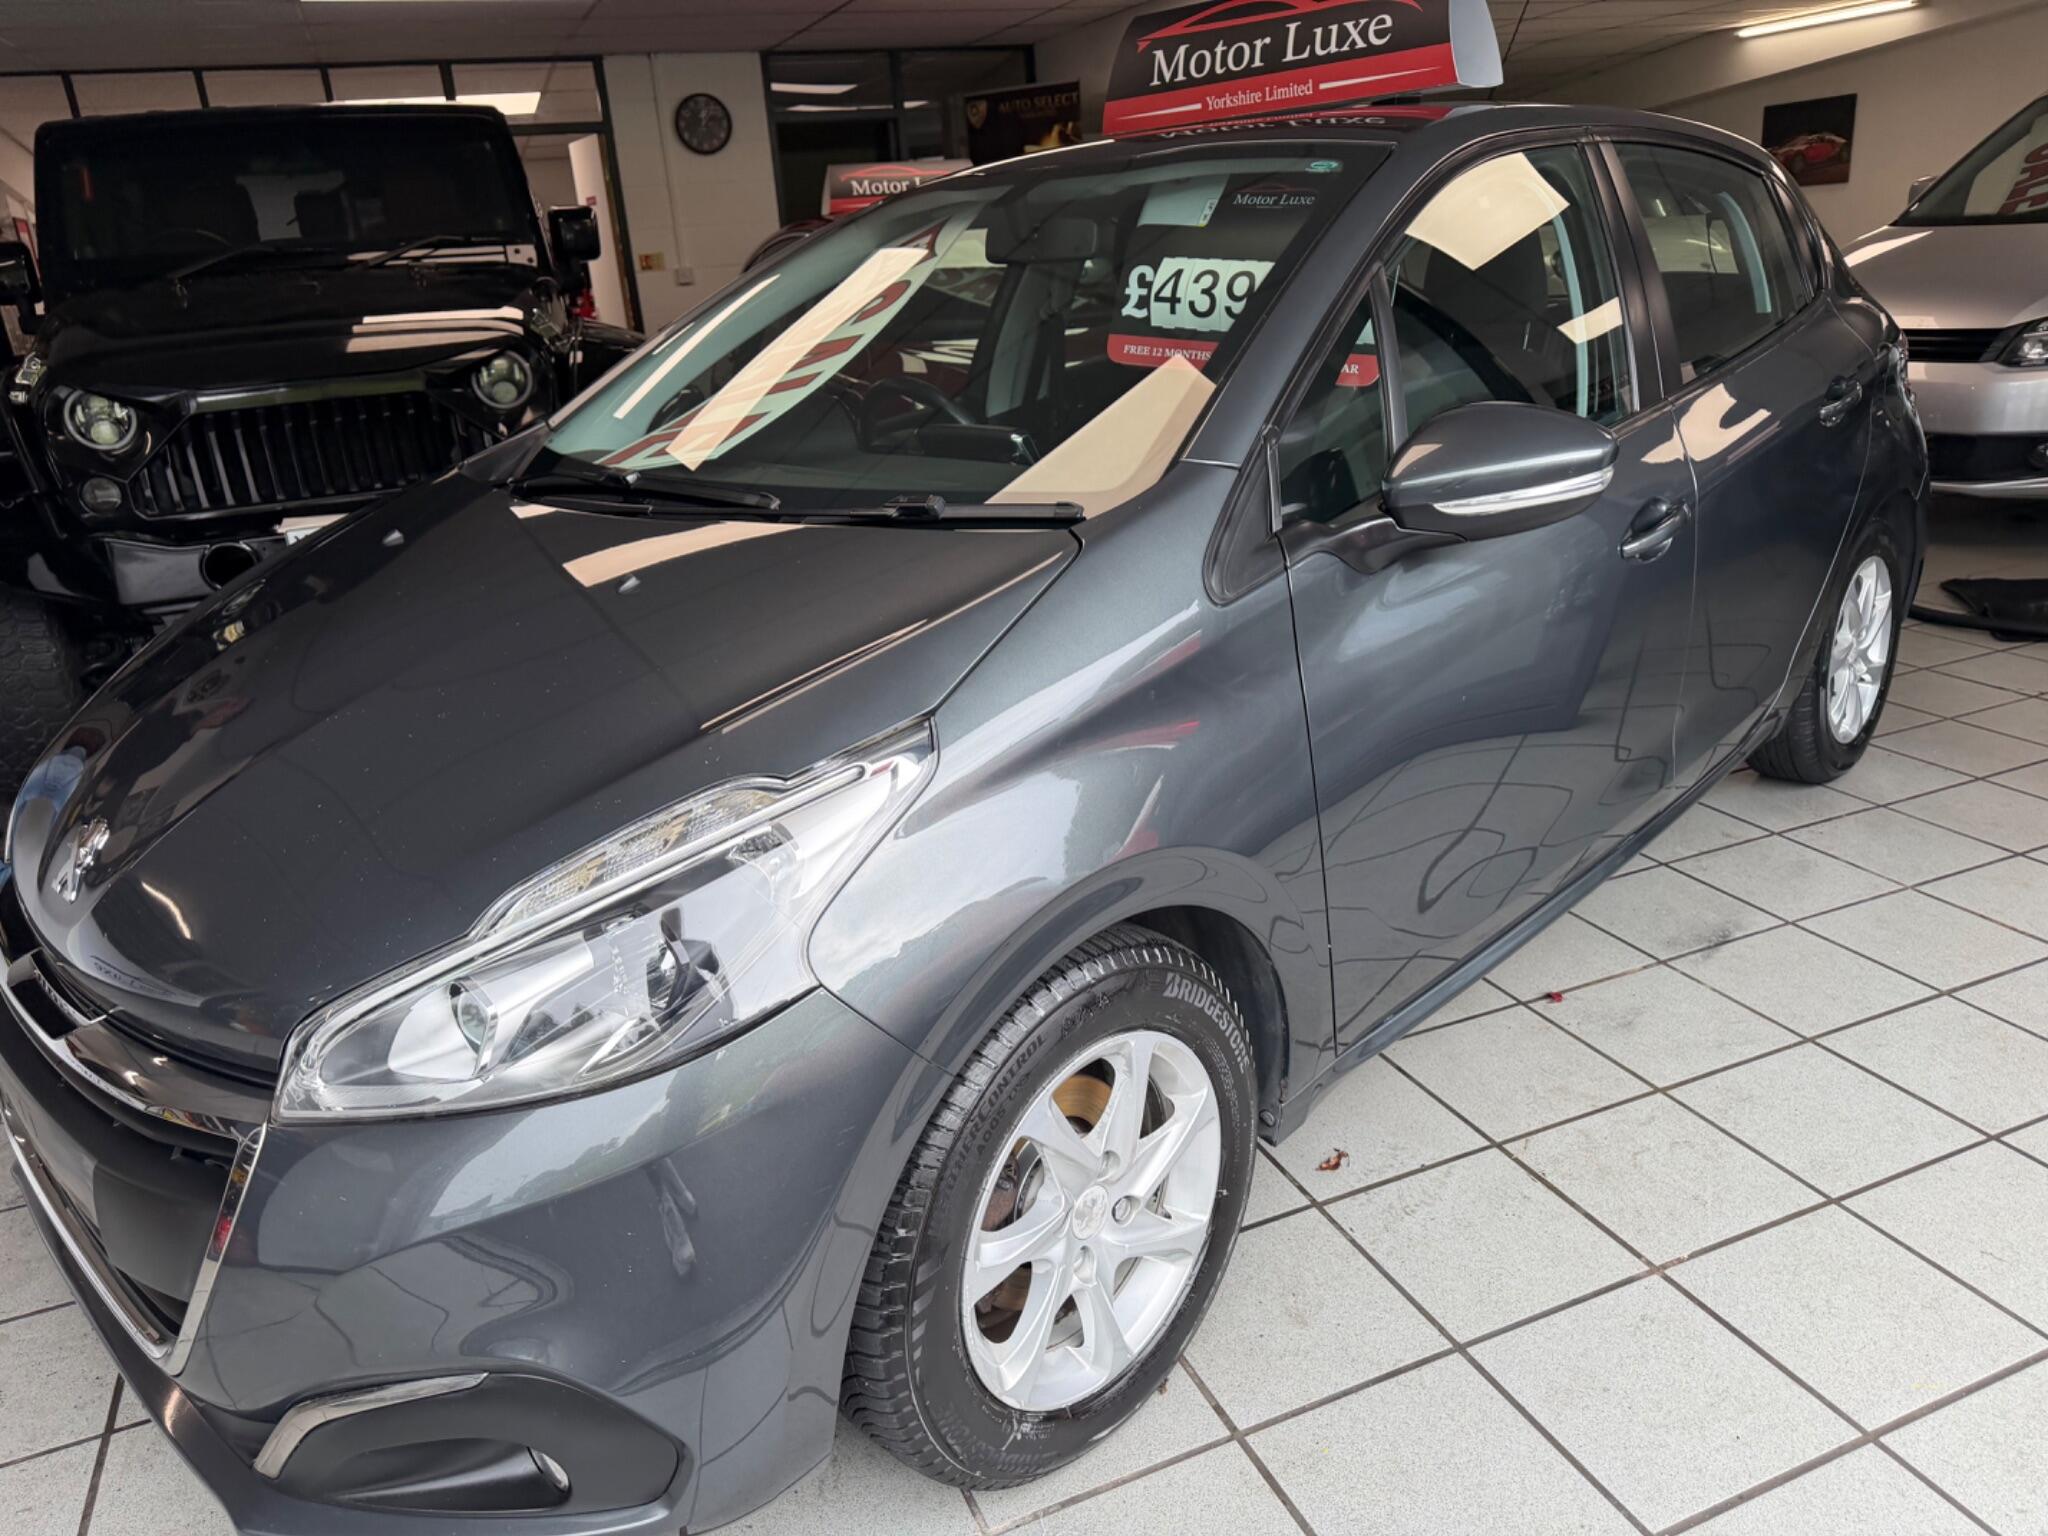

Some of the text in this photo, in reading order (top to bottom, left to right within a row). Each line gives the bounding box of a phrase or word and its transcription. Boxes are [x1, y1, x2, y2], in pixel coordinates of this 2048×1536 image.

[1149, 13, 1393, 87] Motor Luxe
[1206, 79, 1313, 111] Yorkshire Limited
[850, 179, 910, 196] Motor
[1232, 193, 1316, 205] Motor Luxe
[1123, 344, 1213, 361] FREE 12 MONTHS
[1162, 971, 1251, 1075] BRIDGESTONE
